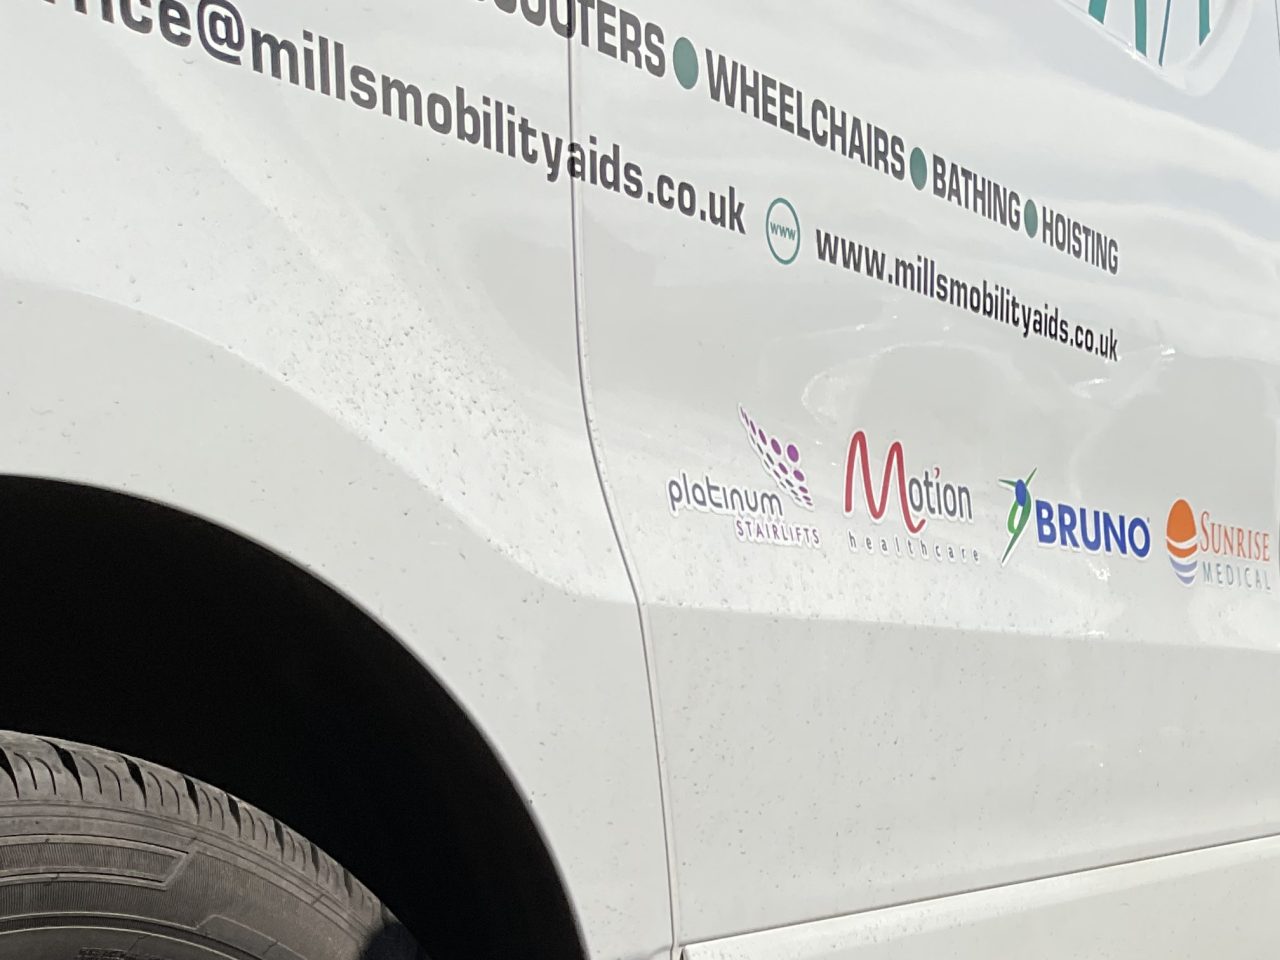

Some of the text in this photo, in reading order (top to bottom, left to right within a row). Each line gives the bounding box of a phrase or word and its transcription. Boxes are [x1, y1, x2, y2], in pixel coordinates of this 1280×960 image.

[42, 0, 746, 235] ce@millsmobilityaids.co.uk
[477, 0, 1119, 275] OTERS WHEELCHAIRS BATHING HOISTING
[815, 228, 1119, 362] www.millsmobilityaids.co.uk
[668, 473, 783, 516] platinum
[845, 430, 973, 534] Motion
[736, 520, 820, 545] STAIRLIFTS
[849, 531, 979, 562] healthcare
[1035, 499, 1150, 558] BRUNO
[1202, 560, 1271, 591] MEDICAL
